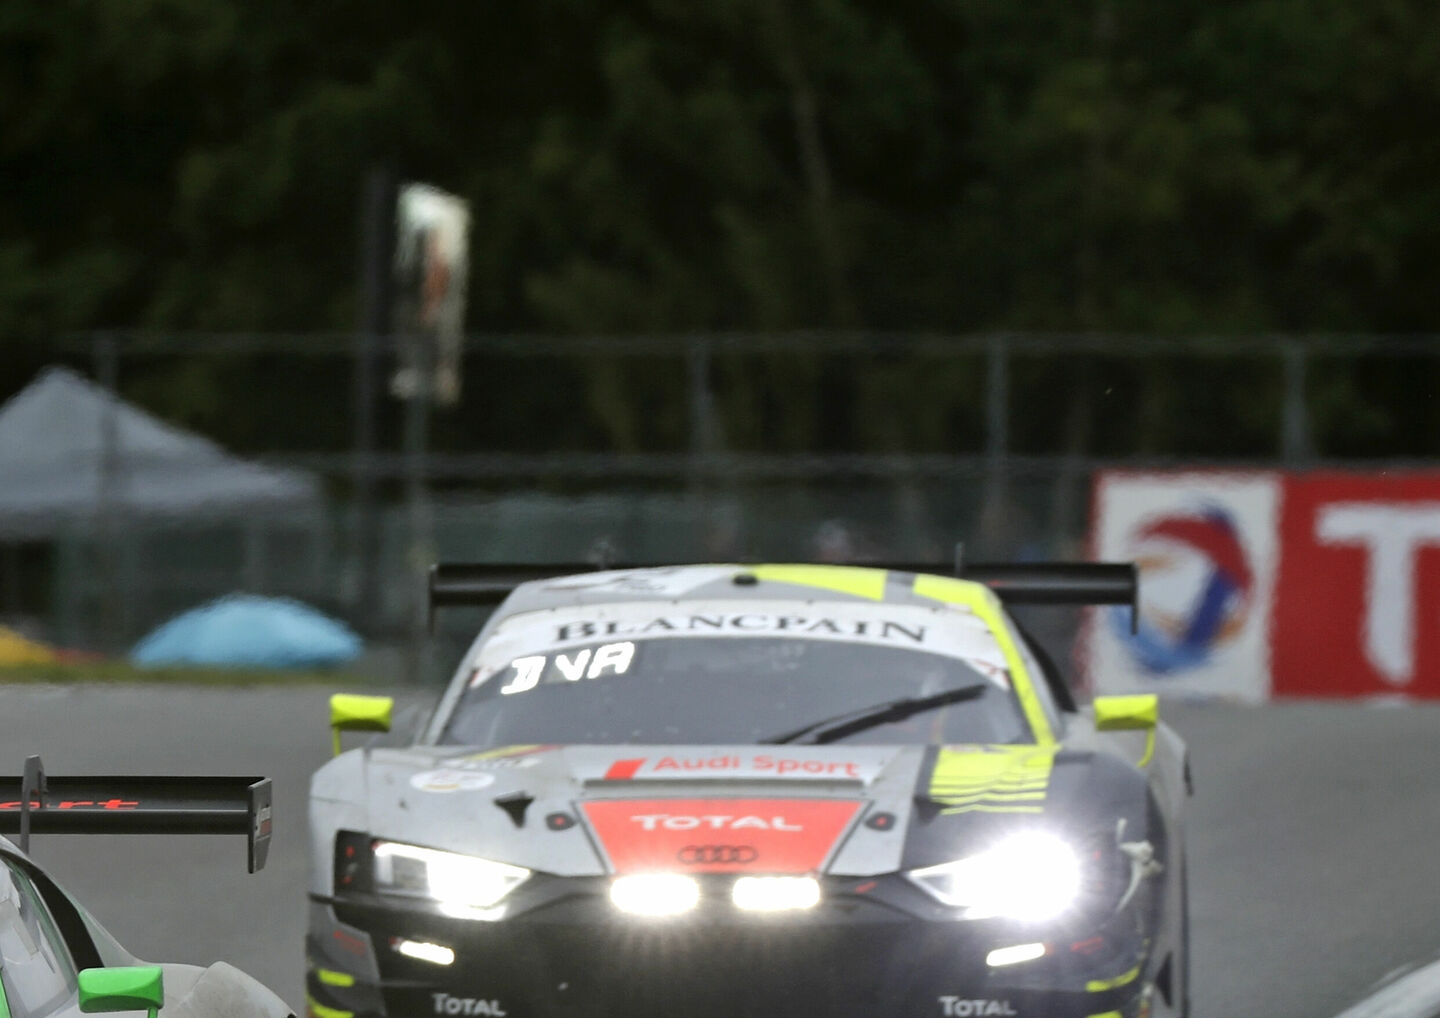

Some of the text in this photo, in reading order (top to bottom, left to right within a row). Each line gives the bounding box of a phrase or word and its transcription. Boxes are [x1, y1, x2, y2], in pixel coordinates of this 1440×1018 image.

[557, 614, 928, 642] BLANCPAIN
[651, 755, 860, 778] Audi Sport
[629, 813, 804, 832] TOTAL
[432, 993, 507, 1017] TOTAL
[939, 995, 1017, 1017] TOTAL
